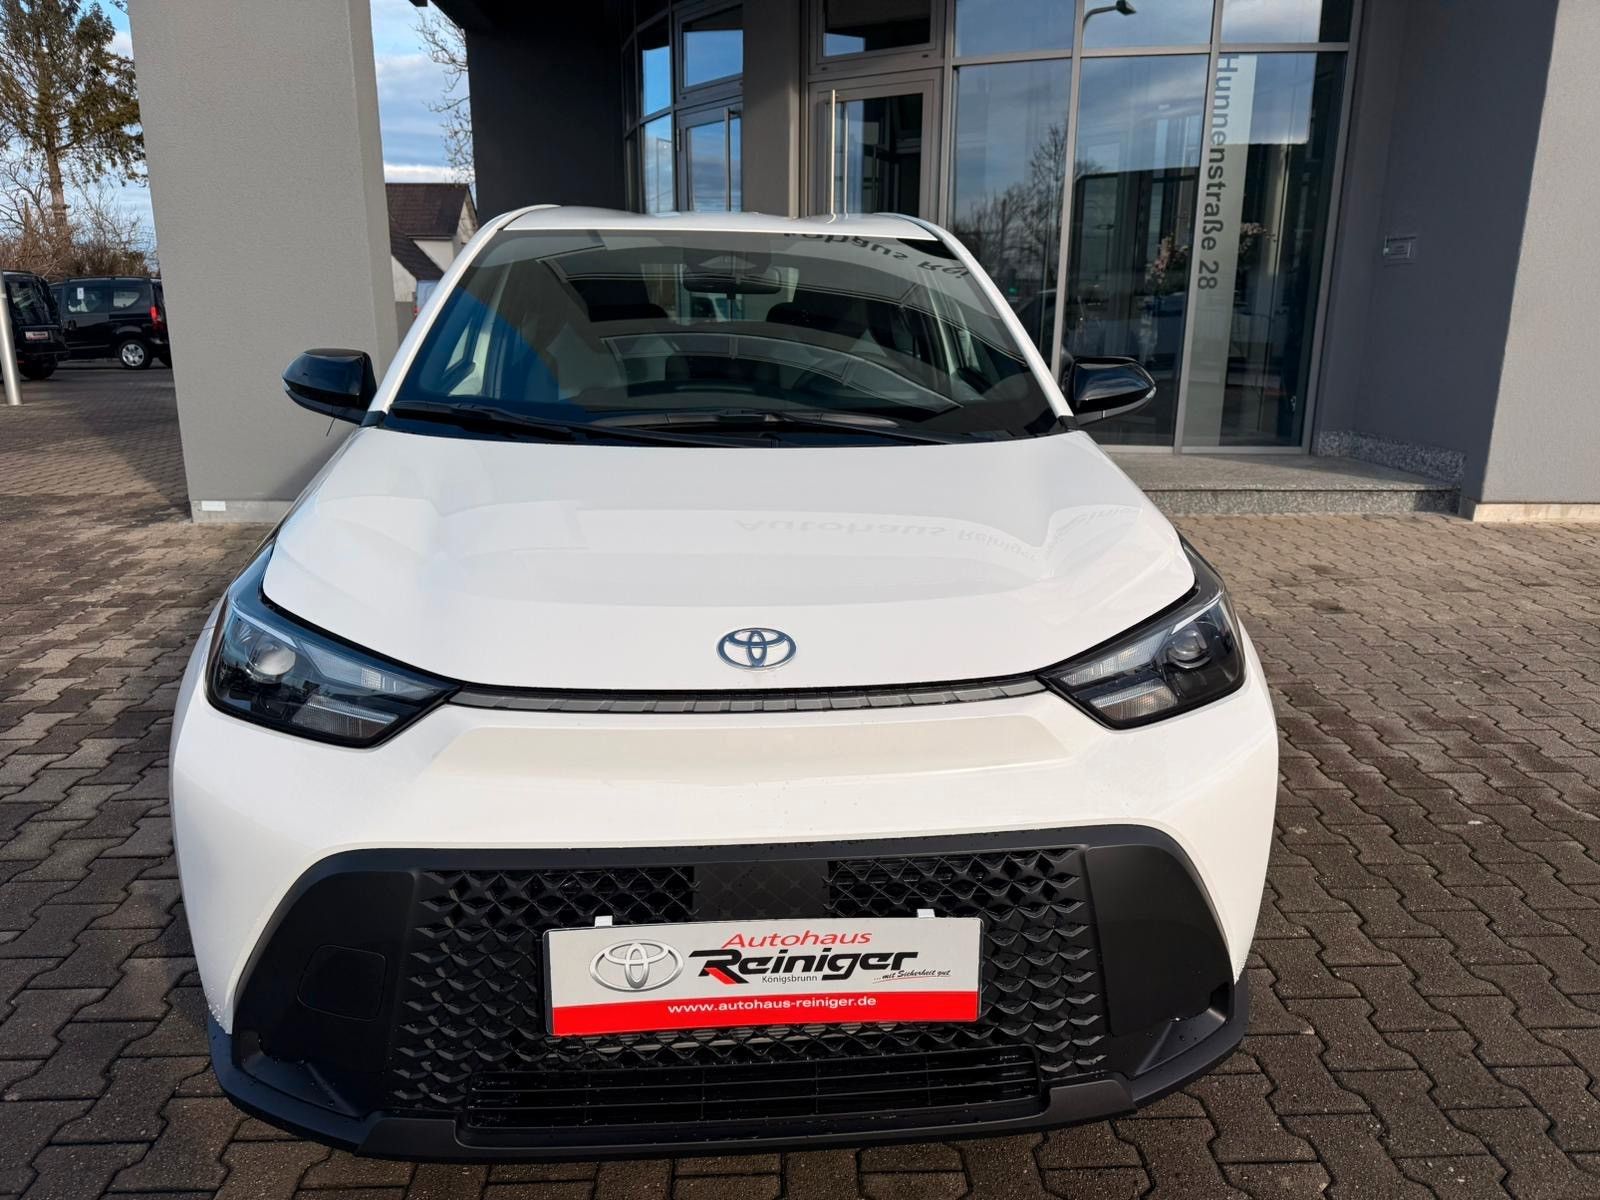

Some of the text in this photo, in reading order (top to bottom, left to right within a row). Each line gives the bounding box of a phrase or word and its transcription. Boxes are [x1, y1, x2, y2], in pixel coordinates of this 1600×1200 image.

[1198, 53, 1239, 289] Hunnenstraße 28
[721, 930, 873, 949] Autohaus
[688, 947, 919, 985] Reiniger
[897, 968, 936, 977] Sicherheit
[761, 975, 818, 985] Königsbrunn
[667, 996, 877, 1014] www.autohaus-reiniger.de
